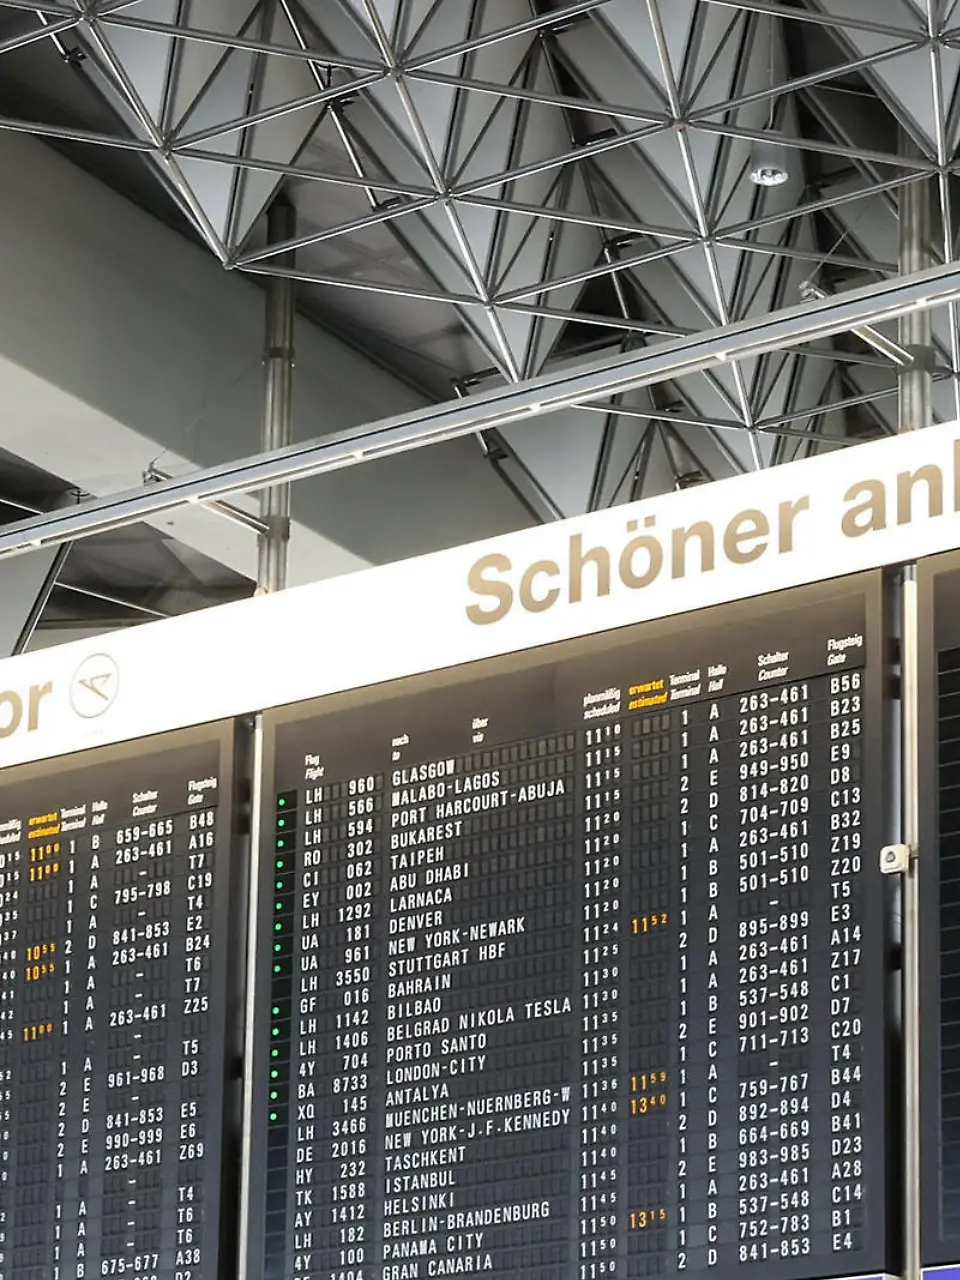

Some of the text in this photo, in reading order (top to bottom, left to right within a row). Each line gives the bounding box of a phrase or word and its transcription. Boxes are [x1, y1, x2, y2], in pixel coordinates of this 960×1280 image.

[466, 490, 809, 628] Schöner
[392, 672, 861, 786] GLASGOW B56
[390, 751, 809, 850] BUKAREST 949-950
[391, 770, 500, 807] MALABO-LAGOS
[391, 779, 565, 828] PORT HARCOURT-ABUJA
[116, 811, 214, 845] 659-665 B48
[390, 845, 444, 870] TAIPEH
[114, 872, 212, 905] 795-798 C19
[389, 862, 469, 892] ABU DHABI
[389, 832, 861, 935] DENVER Z19
[388, 865, 809, 956] NEW YORK-NEWARK 501-510
[390, 887, 453, 913] LARNACA
[112, 920, 170, 945] 841-853
[388, 941, 506, 978] STUTTGART HBF
[387, 973, 451, 999] BAHRAIN
[183, 995, 209, 1015] Z25
[386, 996, 572, 1042] BELGRAD NIKOLA TESLA
[387, 996, 441, 1021] BILBAO
[385, 1018, 861, 1107] ANTALYA C20
[386, 1032, 487, 1063] PORTO SANTO
[108, 1065, 165, 1088] 961-968
[332, 1054, 486, 1094] 8733 LONDON-CITY
[385, 1085, 571, 1129] MUENCHEN-NUERNBERG-W
[105, 1127, 163, 1150] 990-999
[179, 1142, 204, 1161] Z69
[384, 1131, 412, 1150] NEW
[384, 1145, 466, 1172] TASCHKENT
[383, 1143, 810, 1216] HELSINKI 983-985
[386, 1169, 456, 1194] ISTANBUL
[383, 1200, 550, 1238] BERLIN-BRANDENBURG
[383, 1232, 484, 1260] PANAMA CITY
[739, 1237, 811, 1262] 841-853
[428, 1253, 493, 1277] CANARIA
